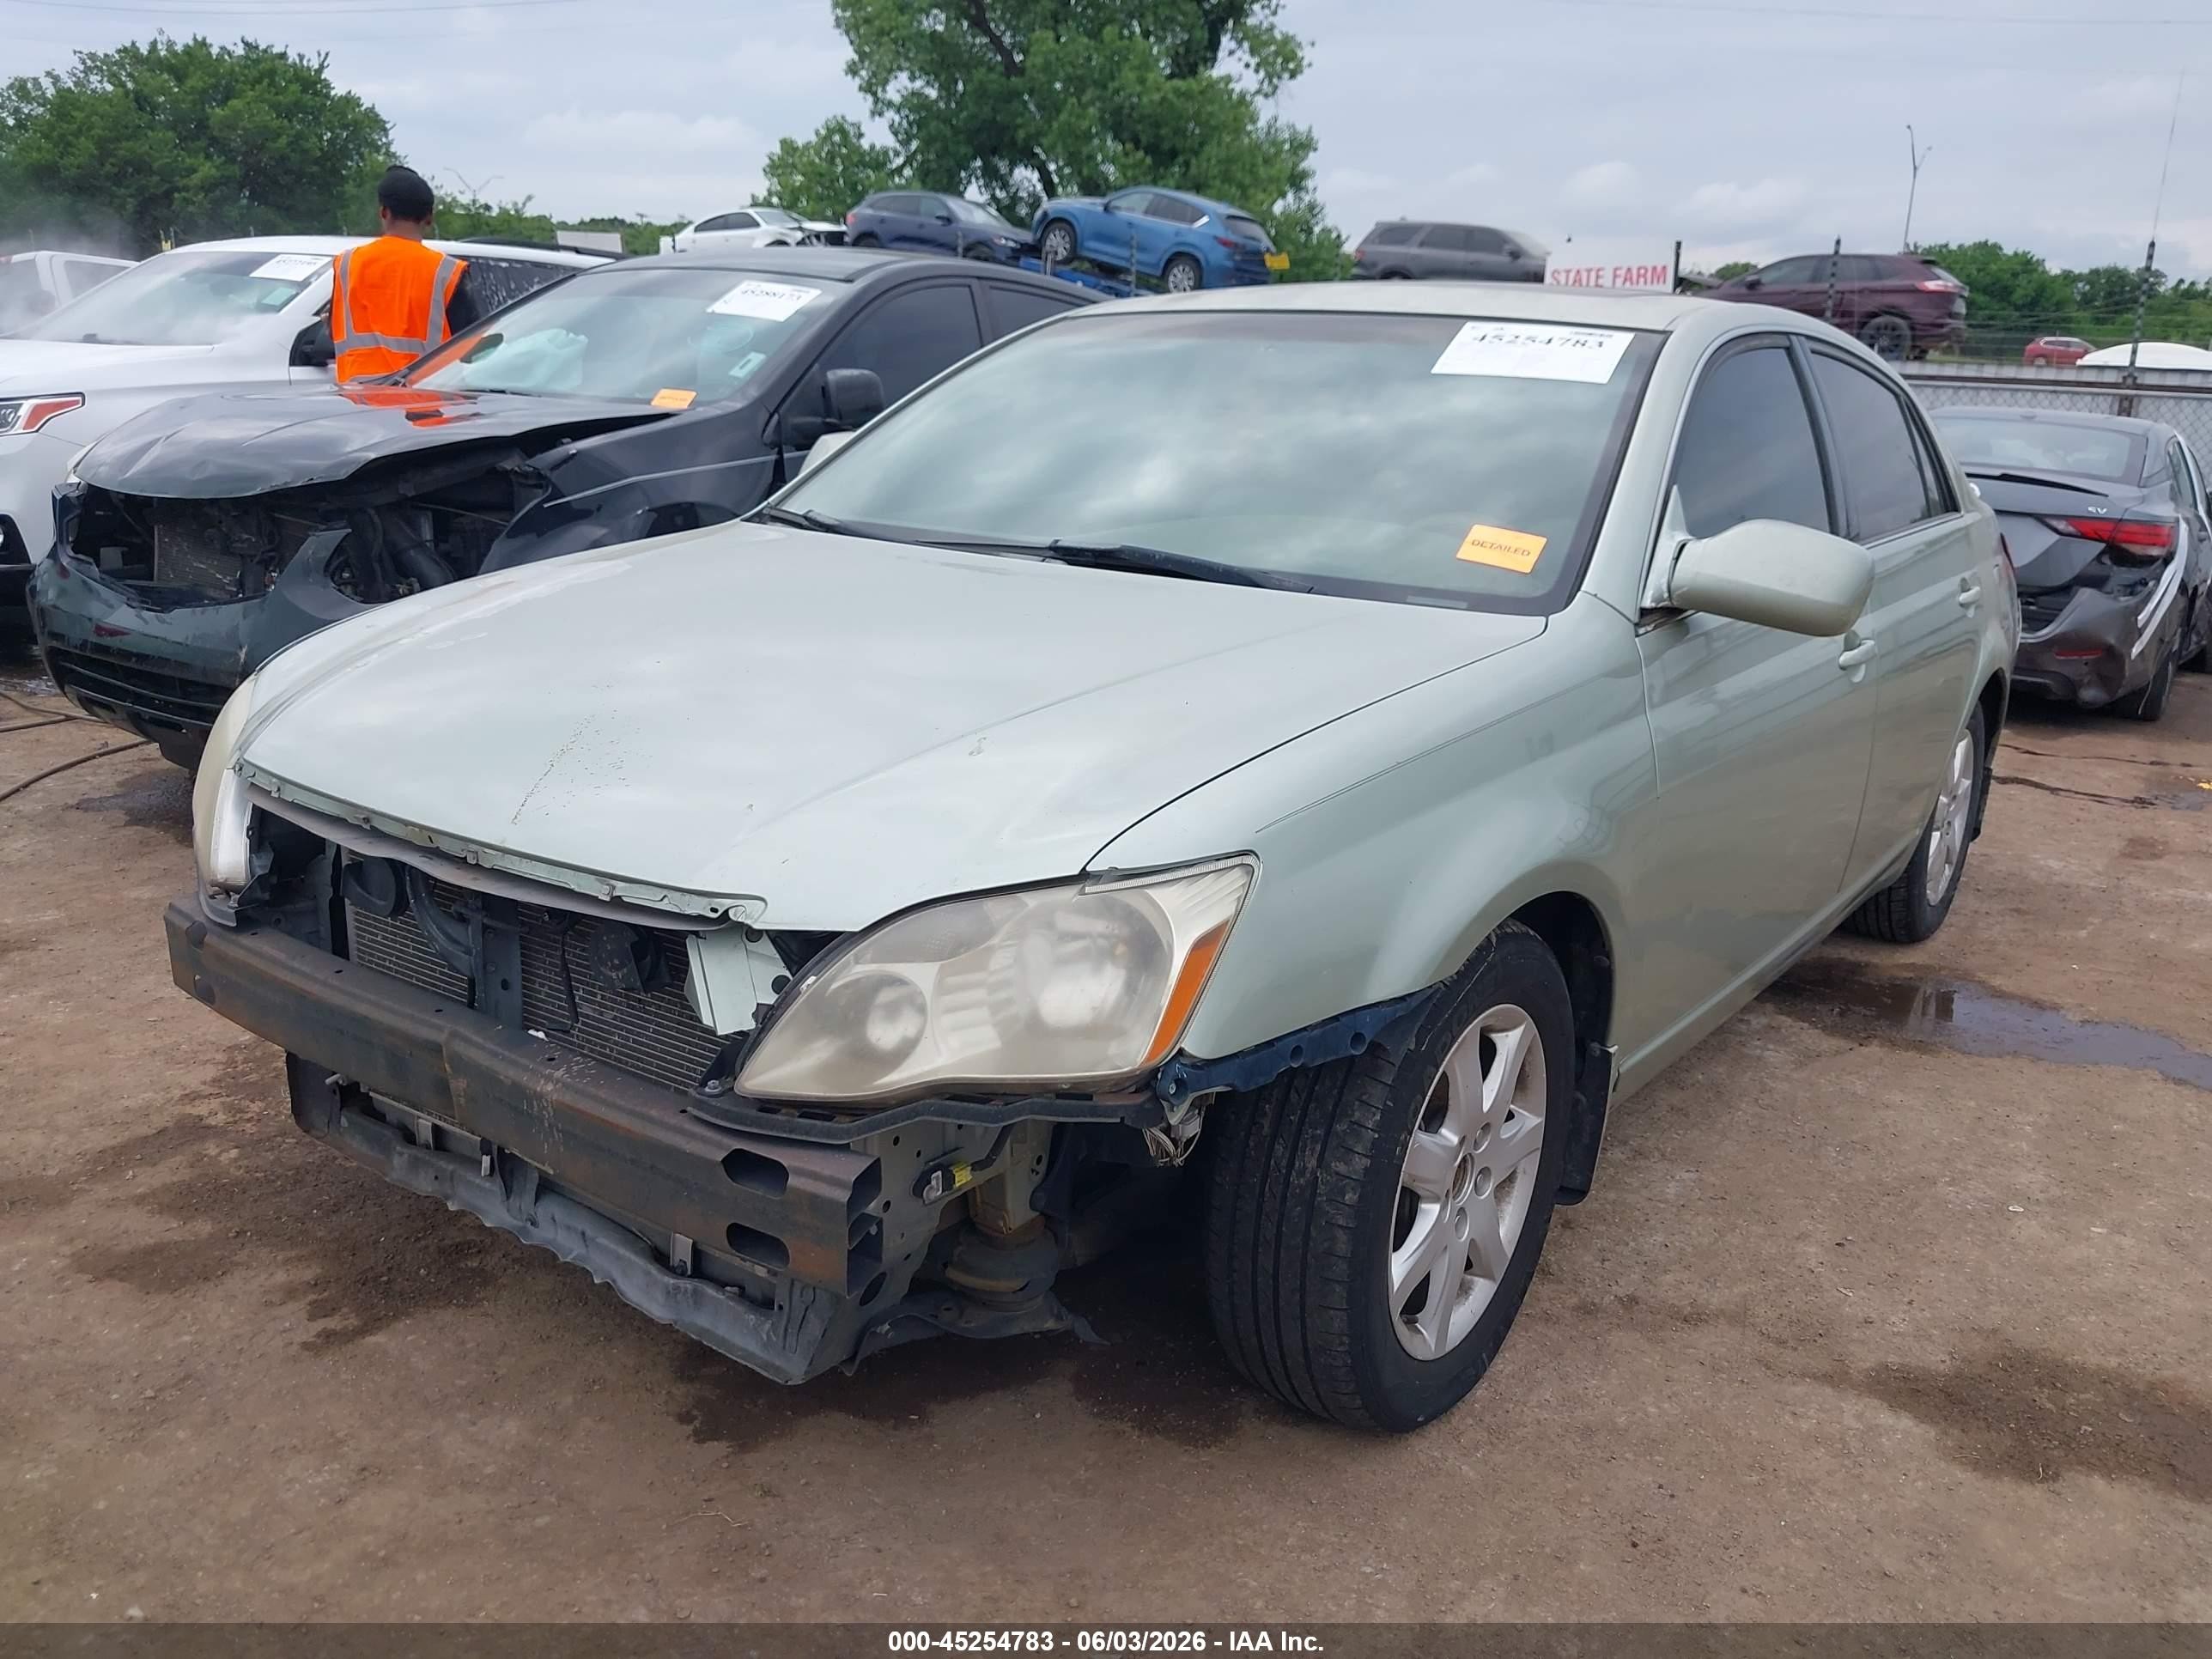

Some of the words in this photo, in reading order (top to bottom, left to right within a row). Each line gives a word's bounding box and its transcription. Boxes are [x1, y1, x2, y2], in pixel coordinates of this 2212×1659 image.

[1551, 267, 1606, 289] STATE
[1612, 264, 1668, 289] FARM
[1472, 332, 1605, 349] 45254783
[2087, 506, 2108, 514] SV
[1471, 538, 1531, 556] DETAILED
